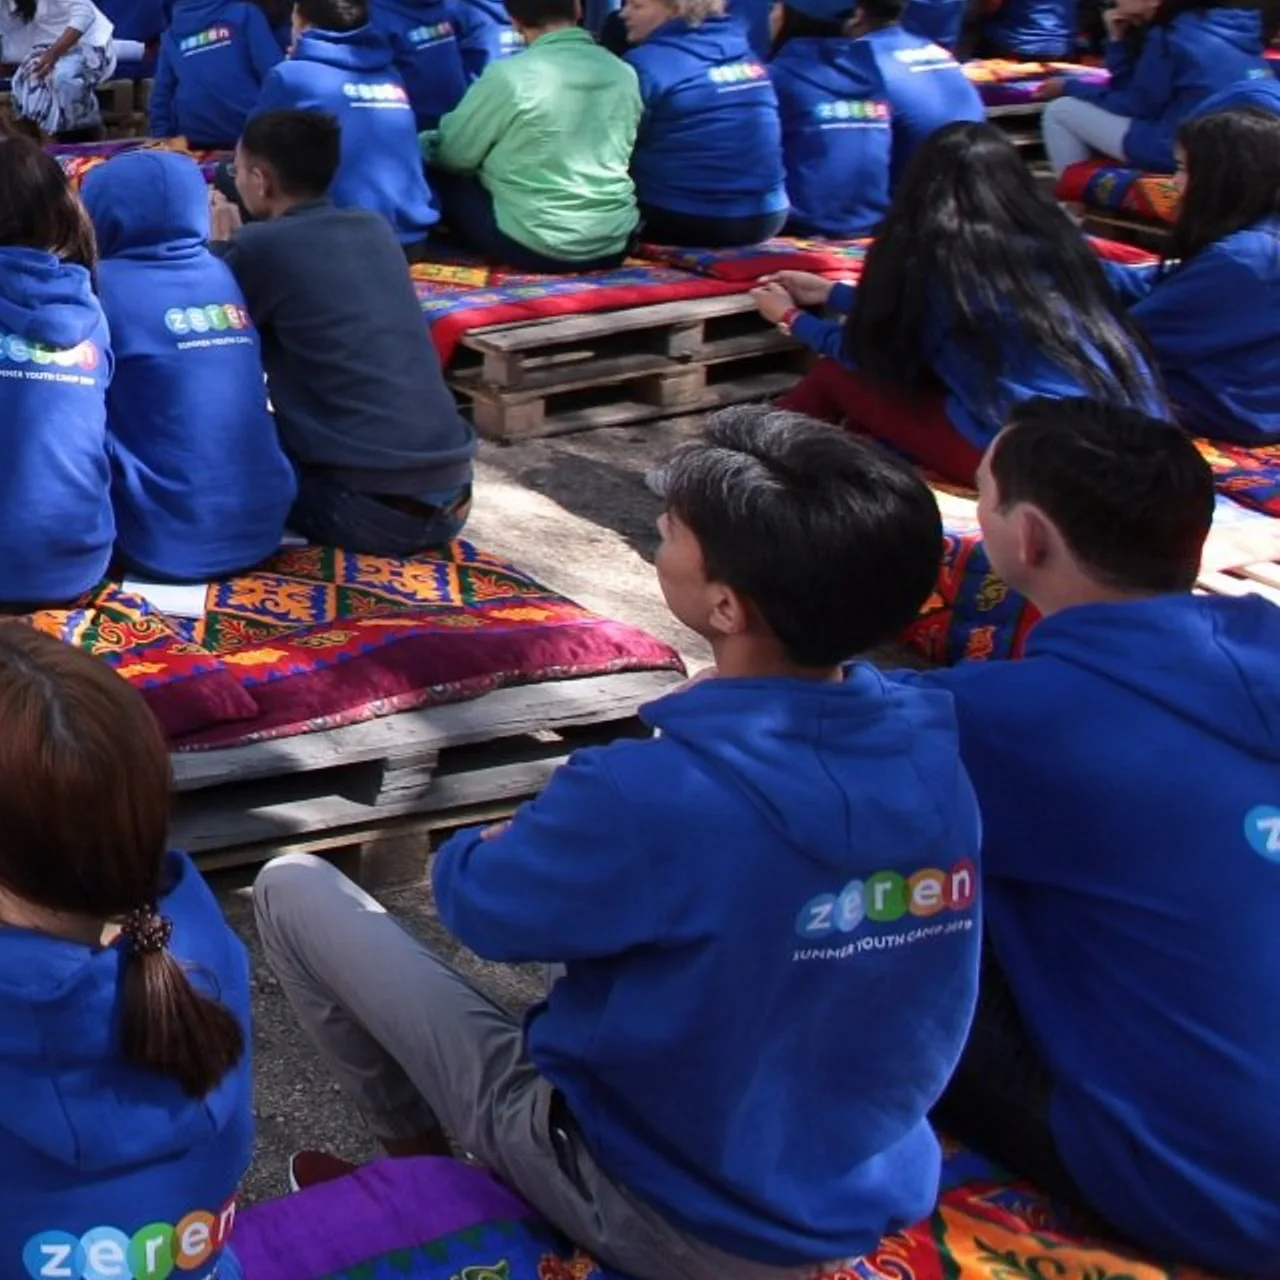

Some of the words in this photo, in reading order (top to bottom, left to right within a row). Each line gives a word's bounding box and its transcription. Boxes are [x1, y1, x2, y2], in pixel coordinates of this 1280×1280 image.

[804, 867, 971, 932] zeren
[855, 933, 905, 952] YOUTH
[39, 1200, 236, 1277] zeren
